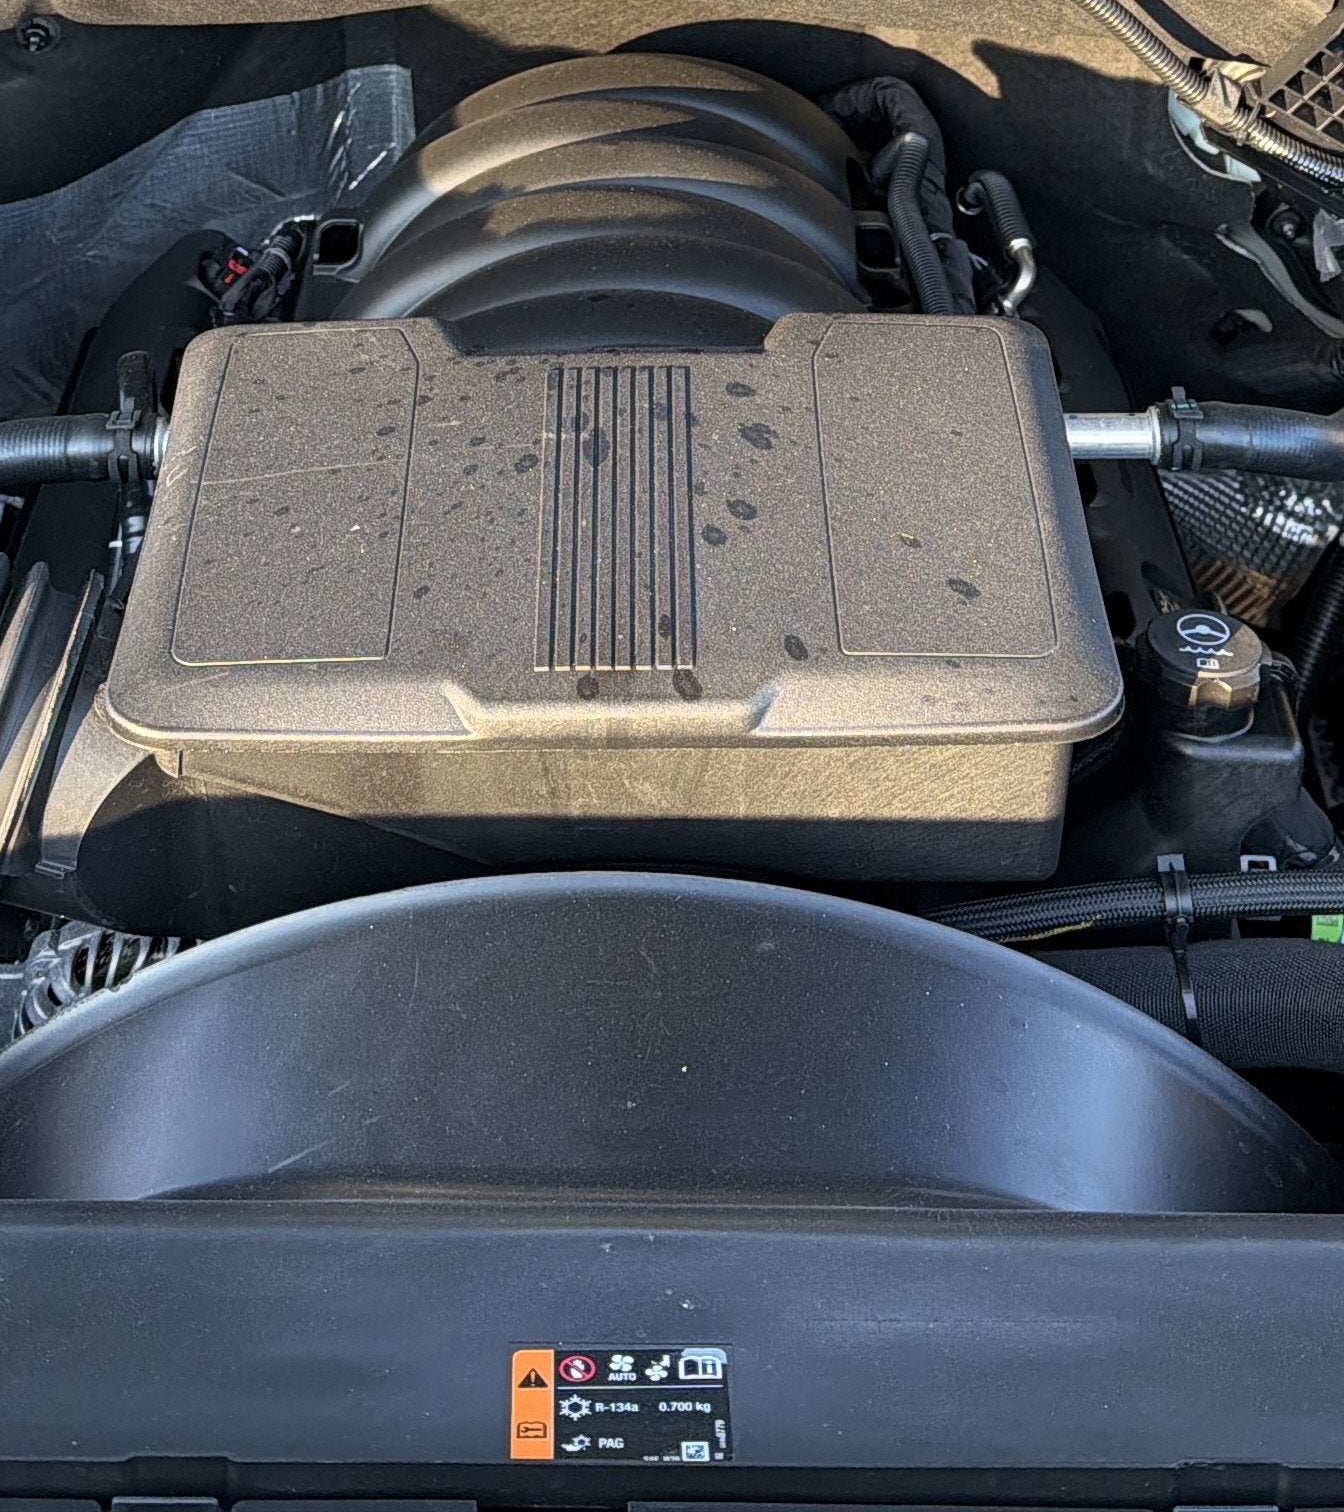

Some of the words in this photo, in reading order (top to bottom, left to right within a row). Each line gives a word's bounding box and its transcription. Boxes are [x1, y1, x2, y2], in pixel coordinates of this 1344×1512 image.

[608, 1373, 637, 1382] AUTO
[595, 1402, 640, 1413] R-134a
[659, 1402, 692, 1412] 0.700
[696, 1402, 711, 1413] kg
[598, 1438, 624, 1449] PAG
